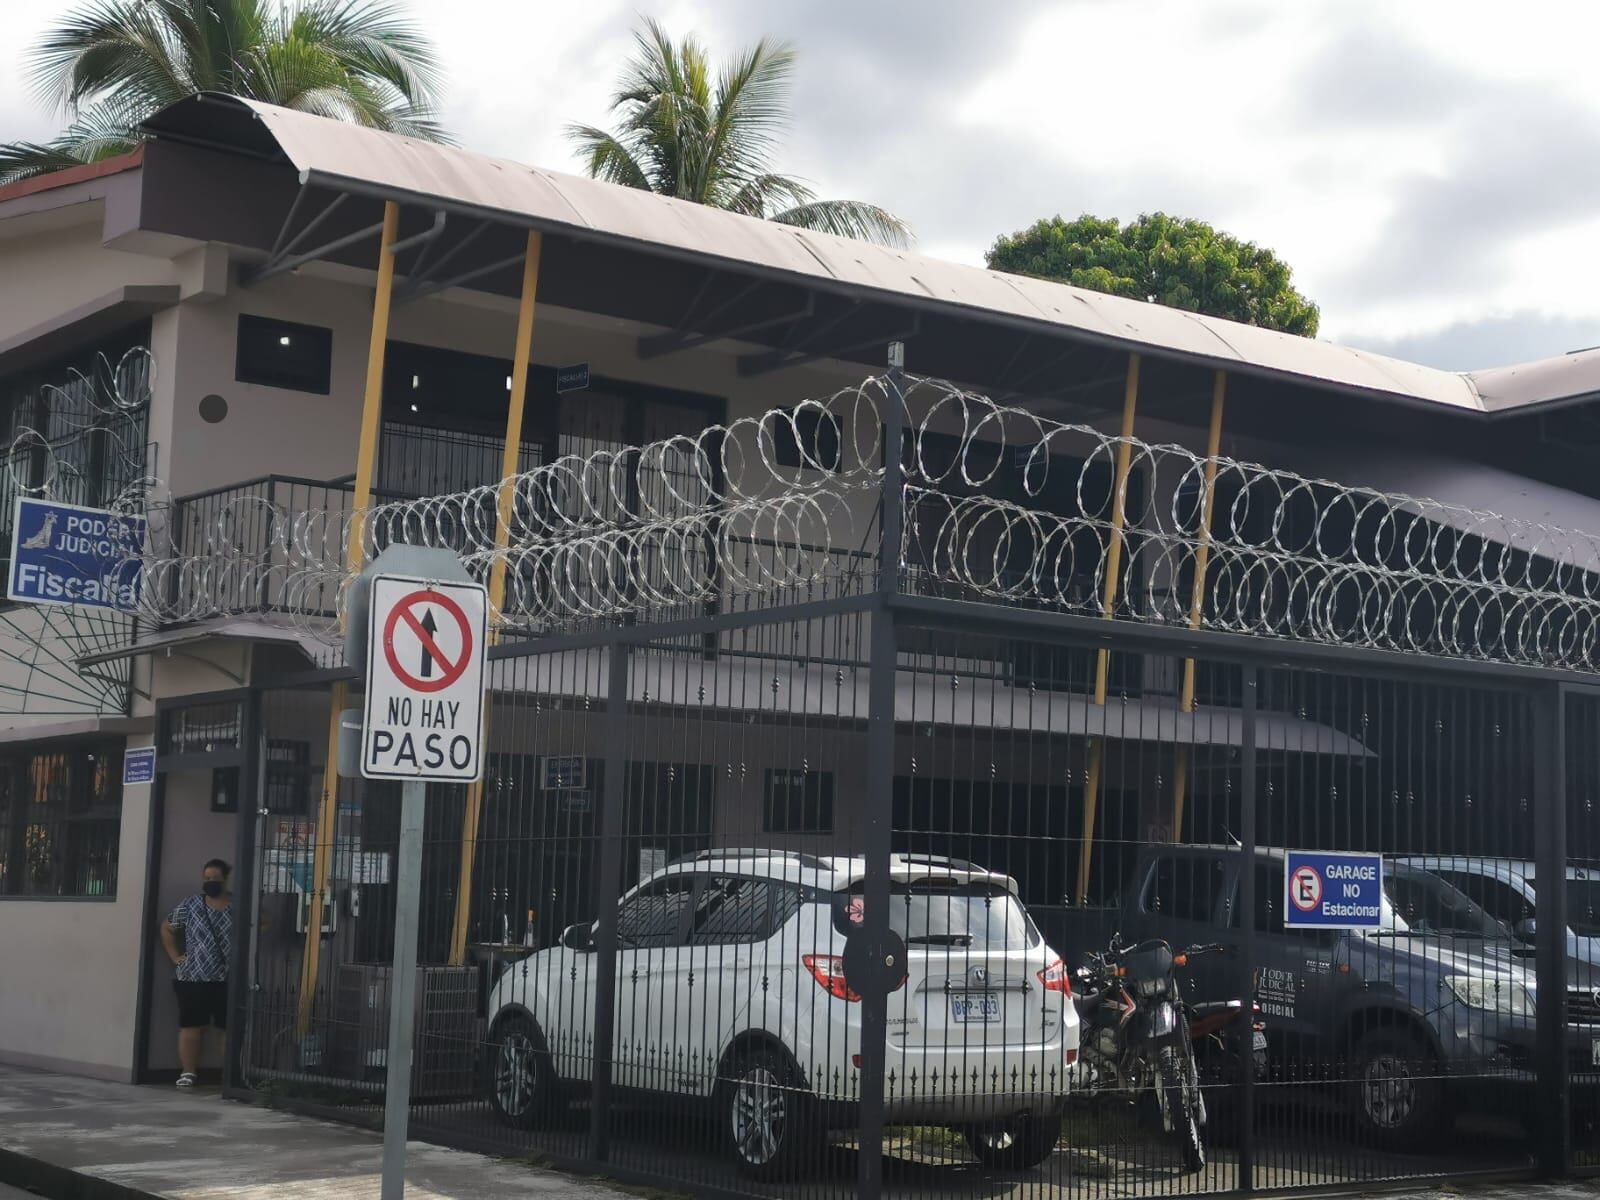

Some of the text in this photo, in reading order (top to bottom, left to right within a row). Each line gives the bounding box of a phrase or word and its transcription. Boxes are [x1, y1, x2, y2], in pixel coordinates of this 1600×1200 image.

[387, 696, 460, 729] NO HAY
[371, 730, 472, 770] PASO
[1326, 864, 1376, 880] GARAGE
[1343, 883, 1360, 898] NO
[1322, 901, 1380, 917] Estacionar
[1261, 1002, 1295, 1018] OFICIAL
